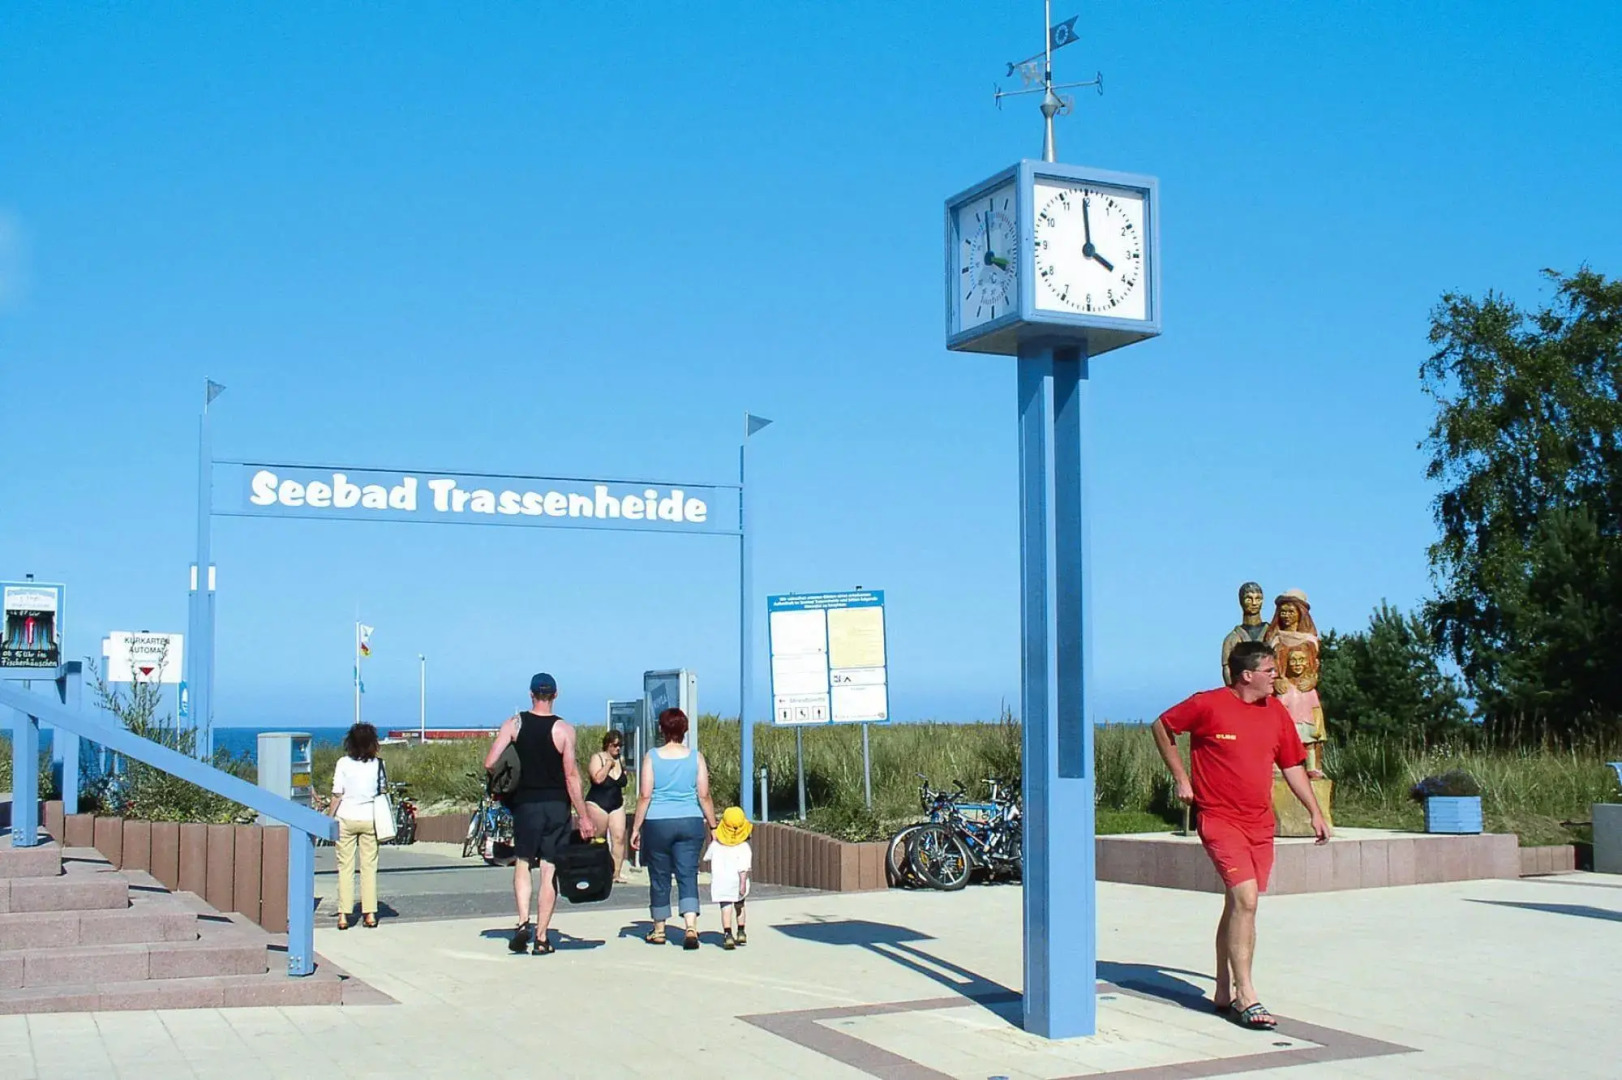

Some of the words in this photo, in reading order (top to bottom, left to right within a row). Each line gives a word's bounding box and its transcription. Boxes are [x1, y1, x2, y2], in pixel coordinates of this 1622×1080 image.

[1063, 202, 1070, 211] 11
[1105, 207, 1110, 216] 1
[1047, 218, 1055, 228] 10
[1121, 227, 1126, 237] 2
[1043, 240, 1048, 250] 9
[1126, 250, 1131, 260] 3
[1049, 265, 1054, 276] 8
[1120, 274, 1126, 283] 4
[1064, 284, 1070, 294] 7
[1107, 289, 1112, 299] 5
[1086, 293, 1091, 303] 6
[250, 470, 417, 511] Seebad
[428, 479, 708, 523] Trassenheide
